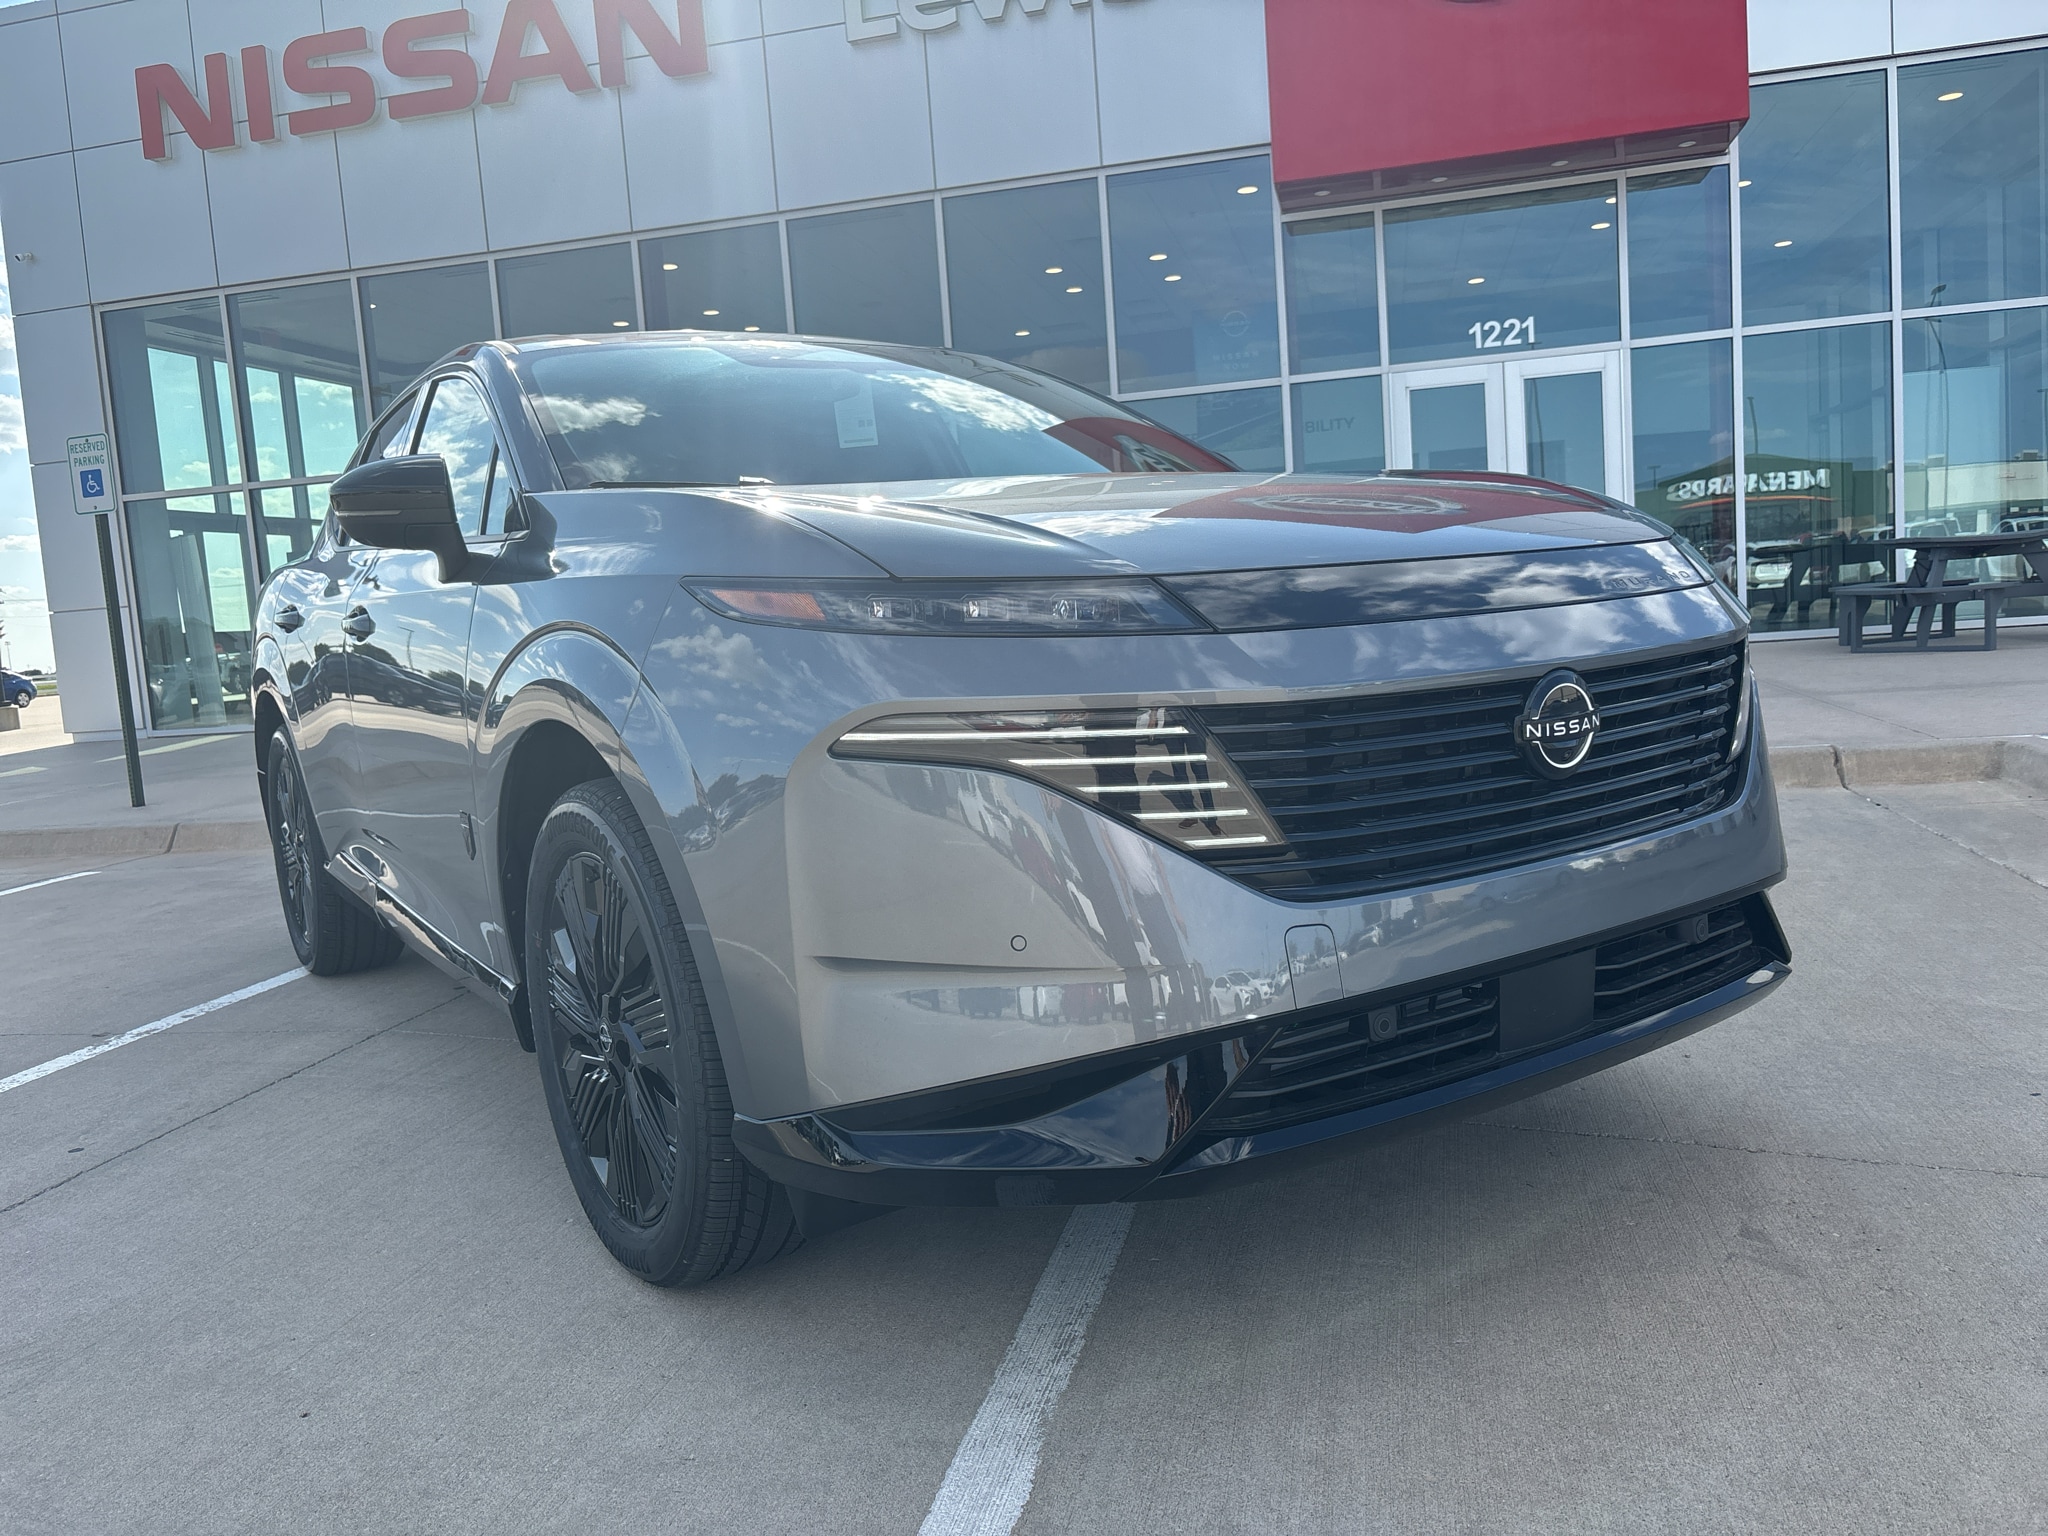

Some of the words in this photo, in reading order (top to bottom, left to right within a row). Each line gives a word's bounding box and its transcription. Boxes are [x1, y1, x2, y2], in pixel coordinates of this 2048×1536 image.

[135, 0, 711, 162] NISSAN
[1468, 315, 1535, 349] 1221
[69, 441, 105, 454] RESERVED
[74, 454, 105, 467] PARKING
[1526, 712, 1600, 738] NISSAN
